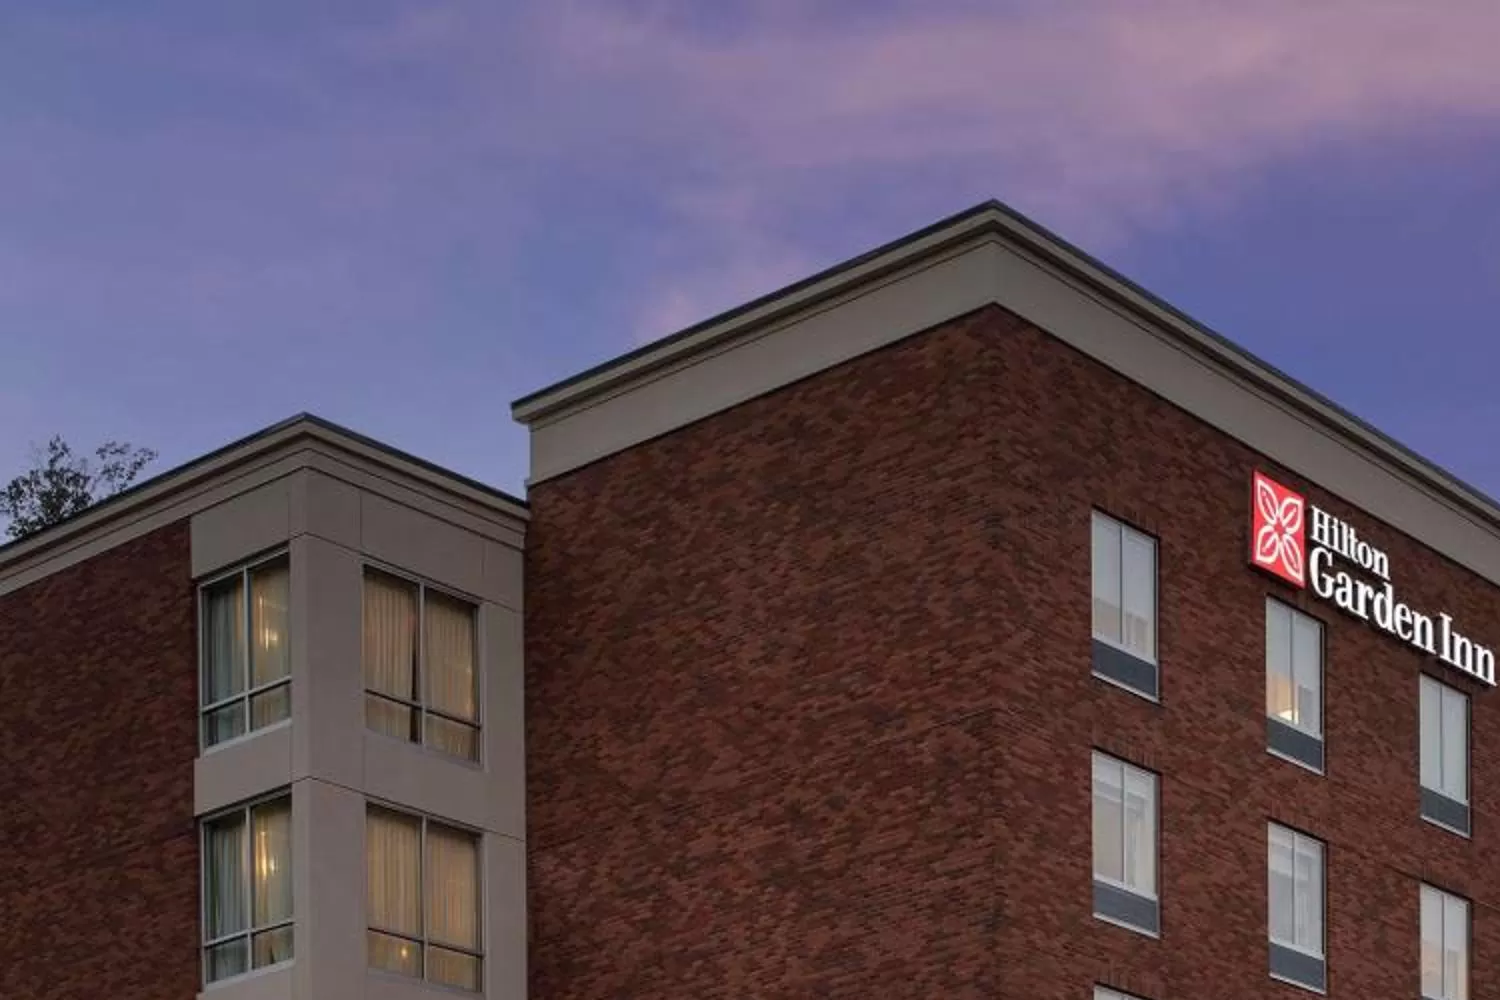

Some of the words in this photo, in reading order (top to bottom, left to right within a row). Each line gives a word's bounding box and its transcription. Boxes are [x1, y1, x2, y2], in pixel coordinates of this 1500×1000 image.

[1309, 505, 1391, 581] Hilton
[1309, 546, 1437, 655] Garden
[1438, 611, 1497, 687] Inn
